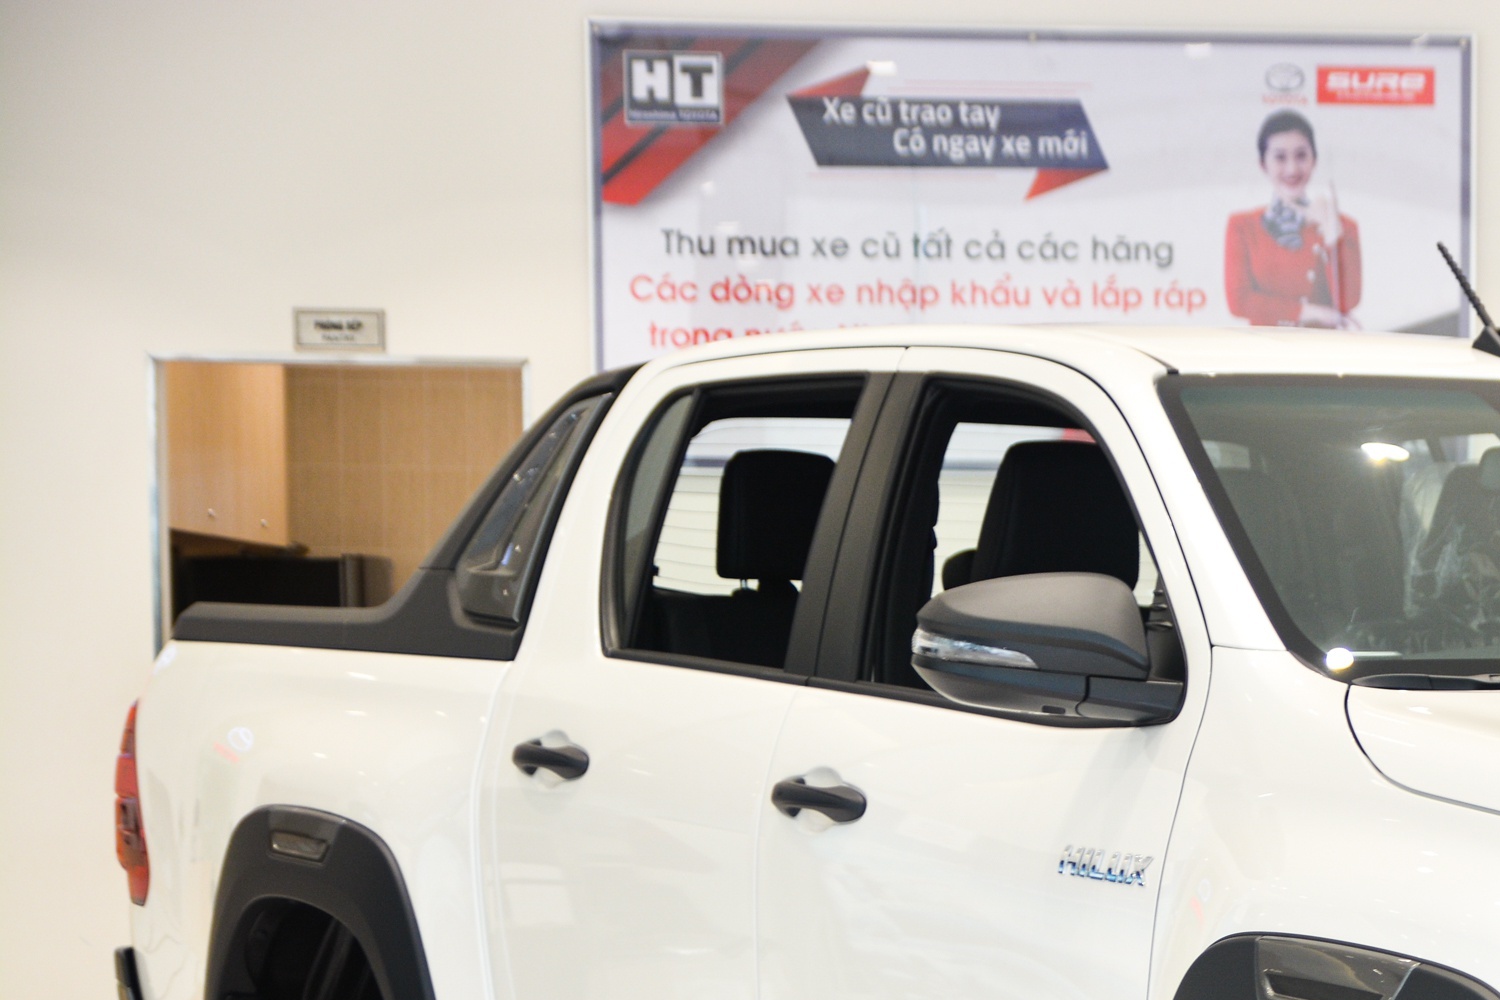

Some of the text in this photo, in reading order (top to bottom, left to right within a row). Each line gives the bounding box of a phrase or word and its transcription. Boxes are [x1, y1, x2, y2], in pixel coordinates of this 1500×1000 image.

[631, 58, 713, 102] HT
[822, 95, 1001, 130] Xe cũ trao tay
[893, 125, 1089, 163] Có ngay xe mới
[661, 227, 1174, 268] Thu mua xe cũ tất cả các hãng
[629, 272, 1208, 314] Các dòng xe nhập khẩu và lắp ráp
[1058, 845, 1154, 887] HILUX
